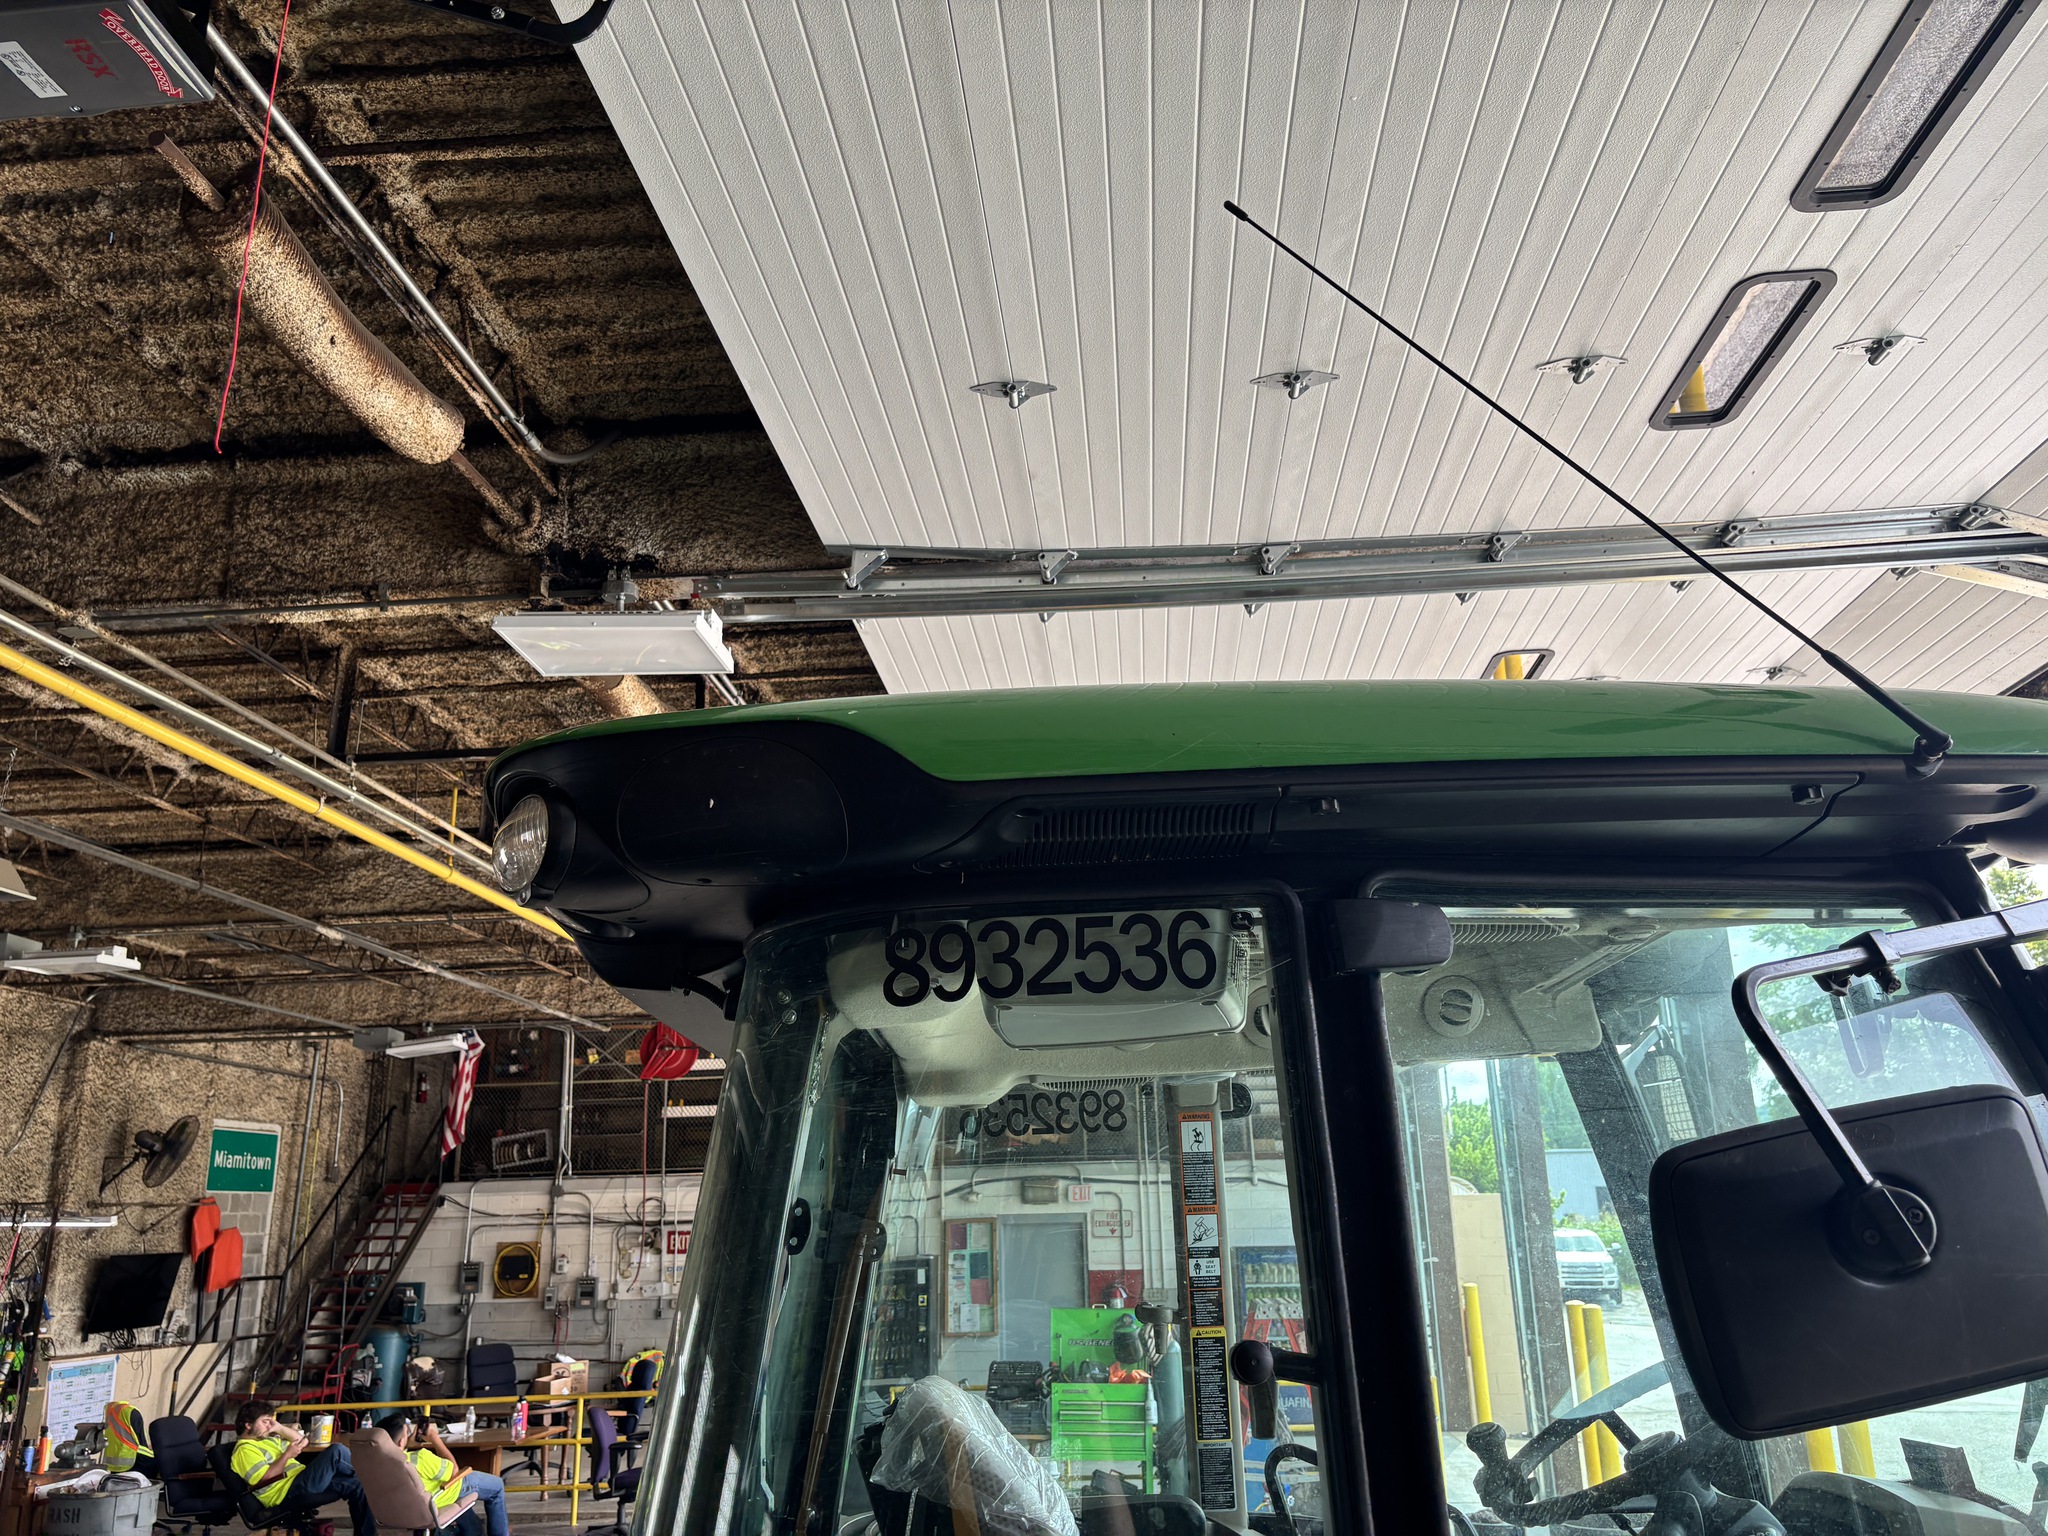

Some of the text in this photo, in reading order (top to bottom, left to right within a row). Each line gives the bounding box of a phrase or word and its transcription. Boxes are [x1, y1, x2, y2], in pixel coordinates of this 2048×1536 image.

[63, 38, 116, 79] RSX
[106, 21, 171, 91] OVERHEAD DOOR
[883, 910, 1218, 1007] 8932536
[214, 1149, 272, 1170] Miamitown
[1072, 1185, 1091, 1201] EXIT
